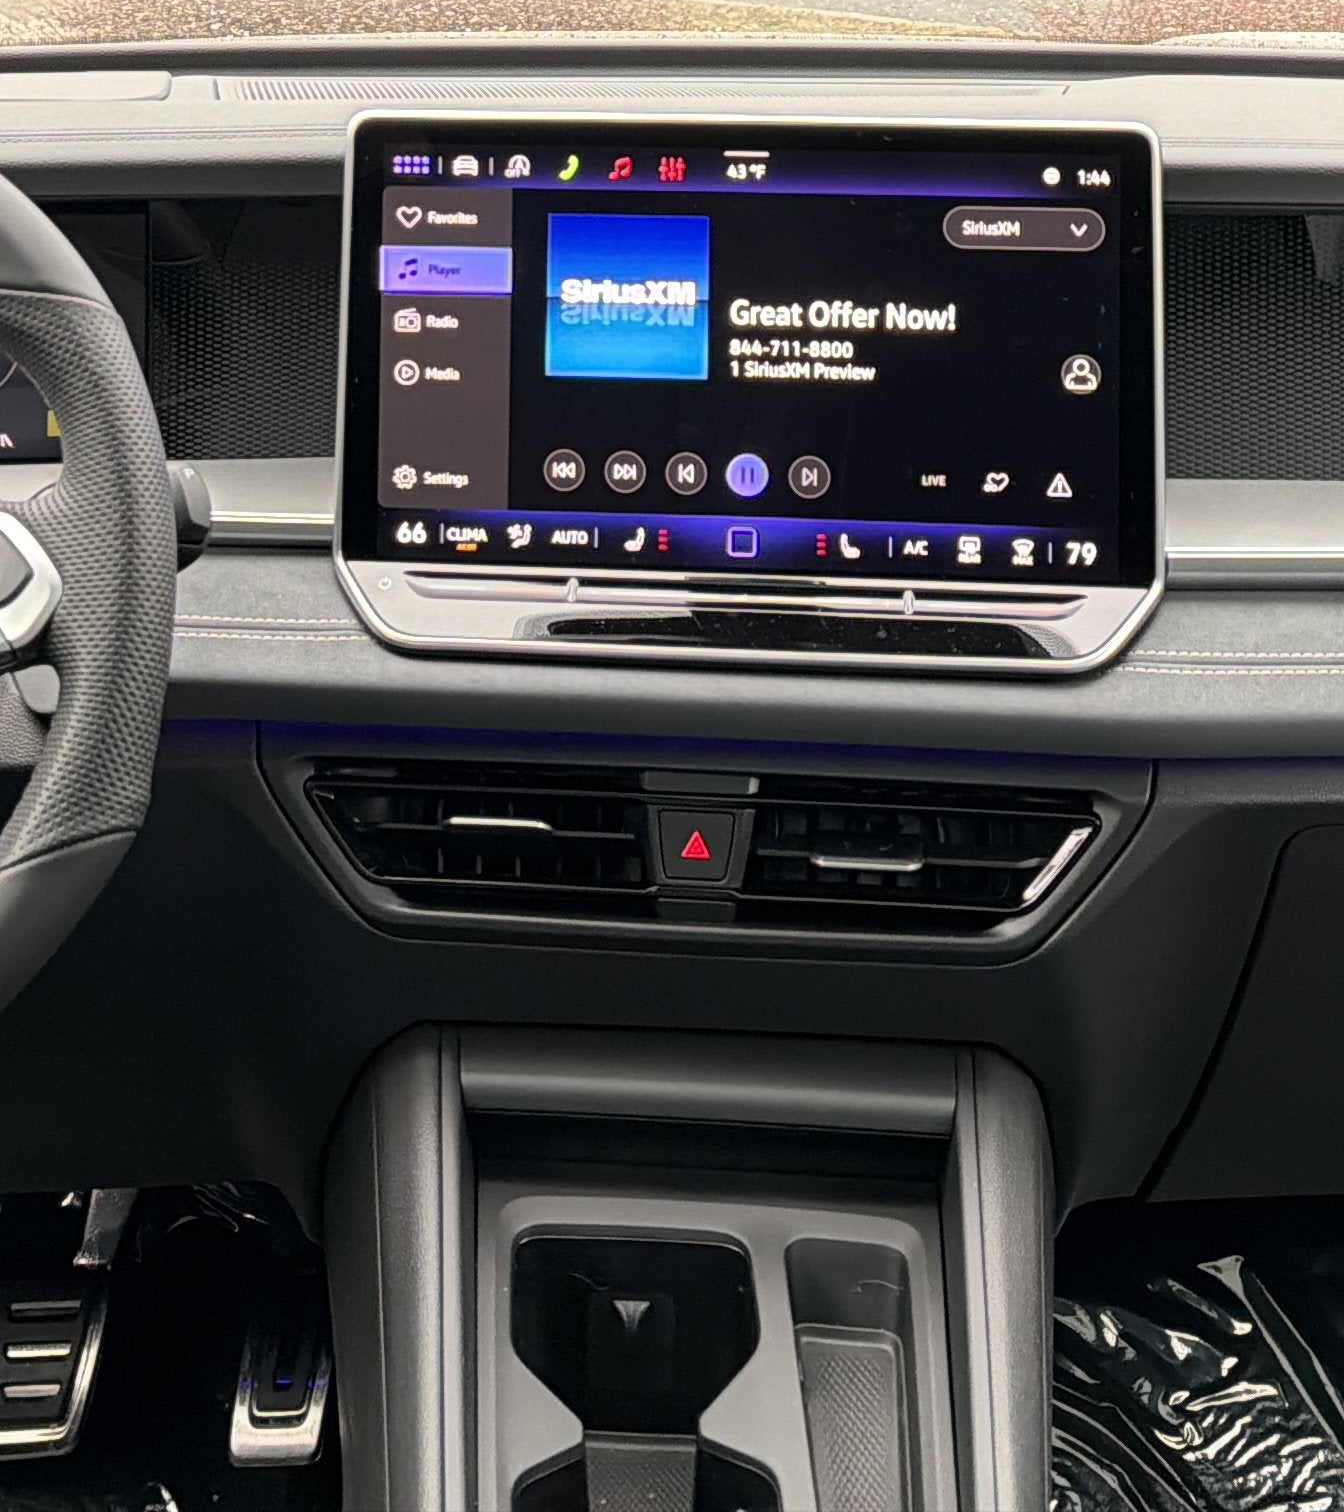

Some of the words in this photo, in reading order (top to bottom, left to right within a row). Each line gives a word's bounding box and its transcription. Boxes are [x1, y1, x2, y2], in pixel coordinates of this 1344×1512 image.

[726, 164, 746, 180] 43
[1077, 169, 1111, 187] 1:44
[426, 211, 479, 226] Favorites
[961, 219, 1021, 237] SiriusXM
[428, 263, 461, 277] Player
[560, 279, 696, 305] SiriusXM
[425, 315, 459, 329] Radio
[729, 298, 803, 328] Great
[808, 300, 880, 329] Offer
[885, 302, 957, 331] Now!
[729, 338, 854, 359] 844-711-8800
[425, 367, 461, 381] Media
[730, 360, 739, 377] 1
[744, 361, 811, 379] SiriusXM
[814, 362, 877, 382] Preview
[422, 471, 469, 488] Settings
[921, 474, 947, 487] LIVE
[396, 521, 428, 544] 66
[446, 527, 489, 543] CLIMA
[550, 529, 589, 545] AUTO
[903, 540, 929, 556] A/C
[1064, 541, 1098, 566] 79
